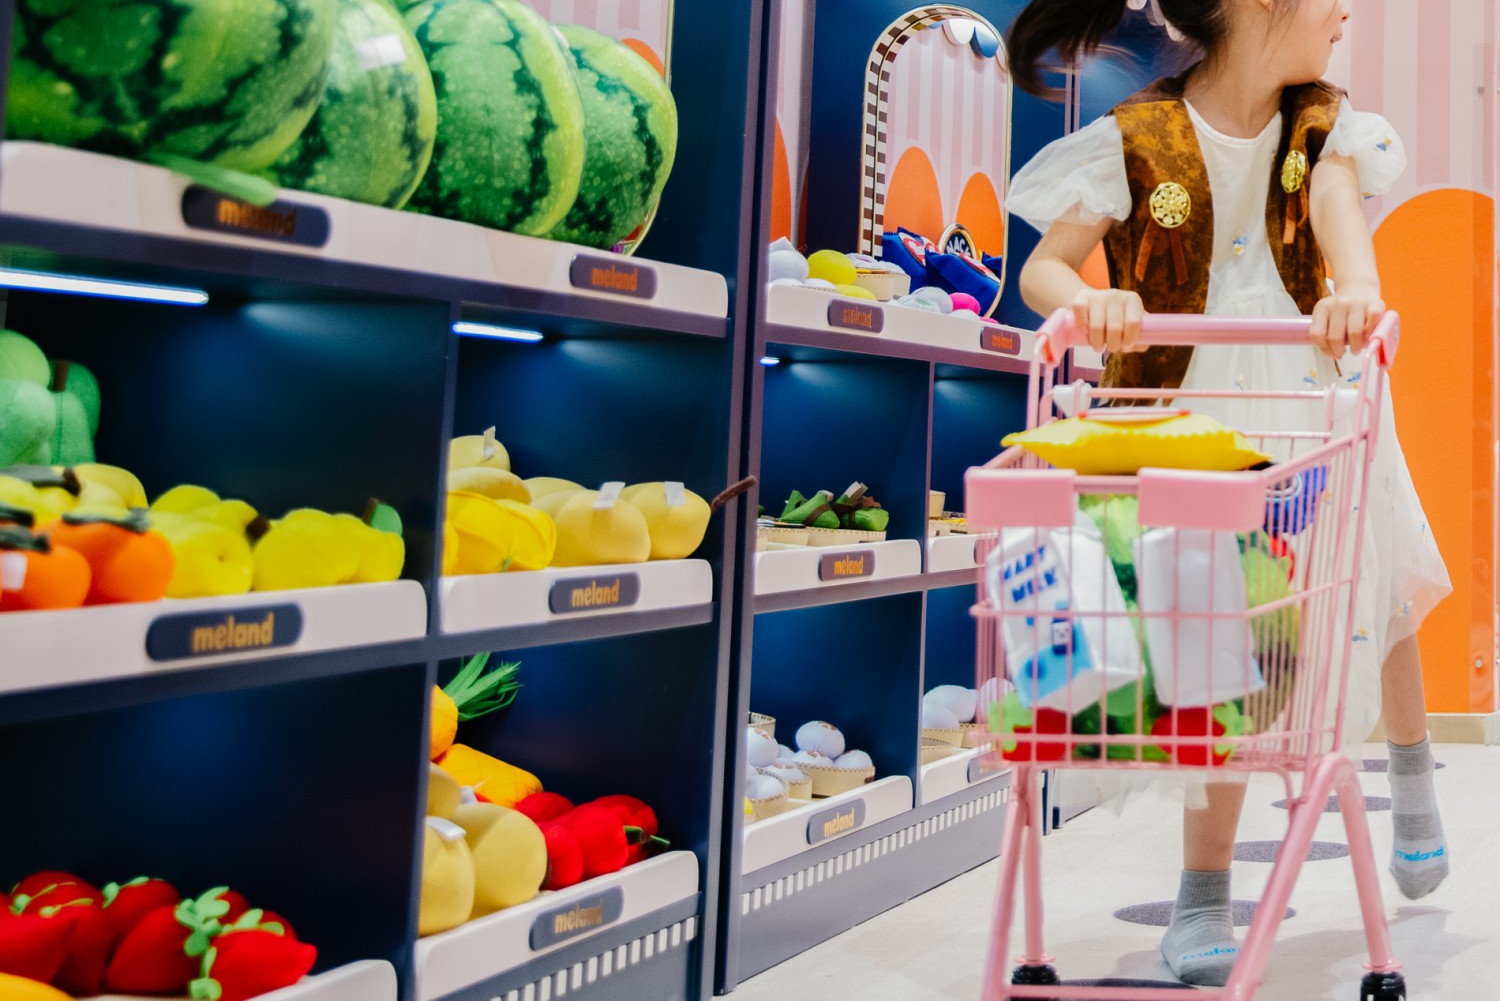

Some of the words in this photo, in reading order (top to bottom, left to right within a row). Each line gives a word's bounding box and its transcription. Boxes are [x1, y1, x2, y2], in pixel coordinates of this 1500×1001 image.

[591, 264, 638, 292] meland
[834, 554, 864, 576] meland
[571, 578, 620, 608] meland
[192, 611, 275, 653] meland
[823, 807, 855, 838] meland
